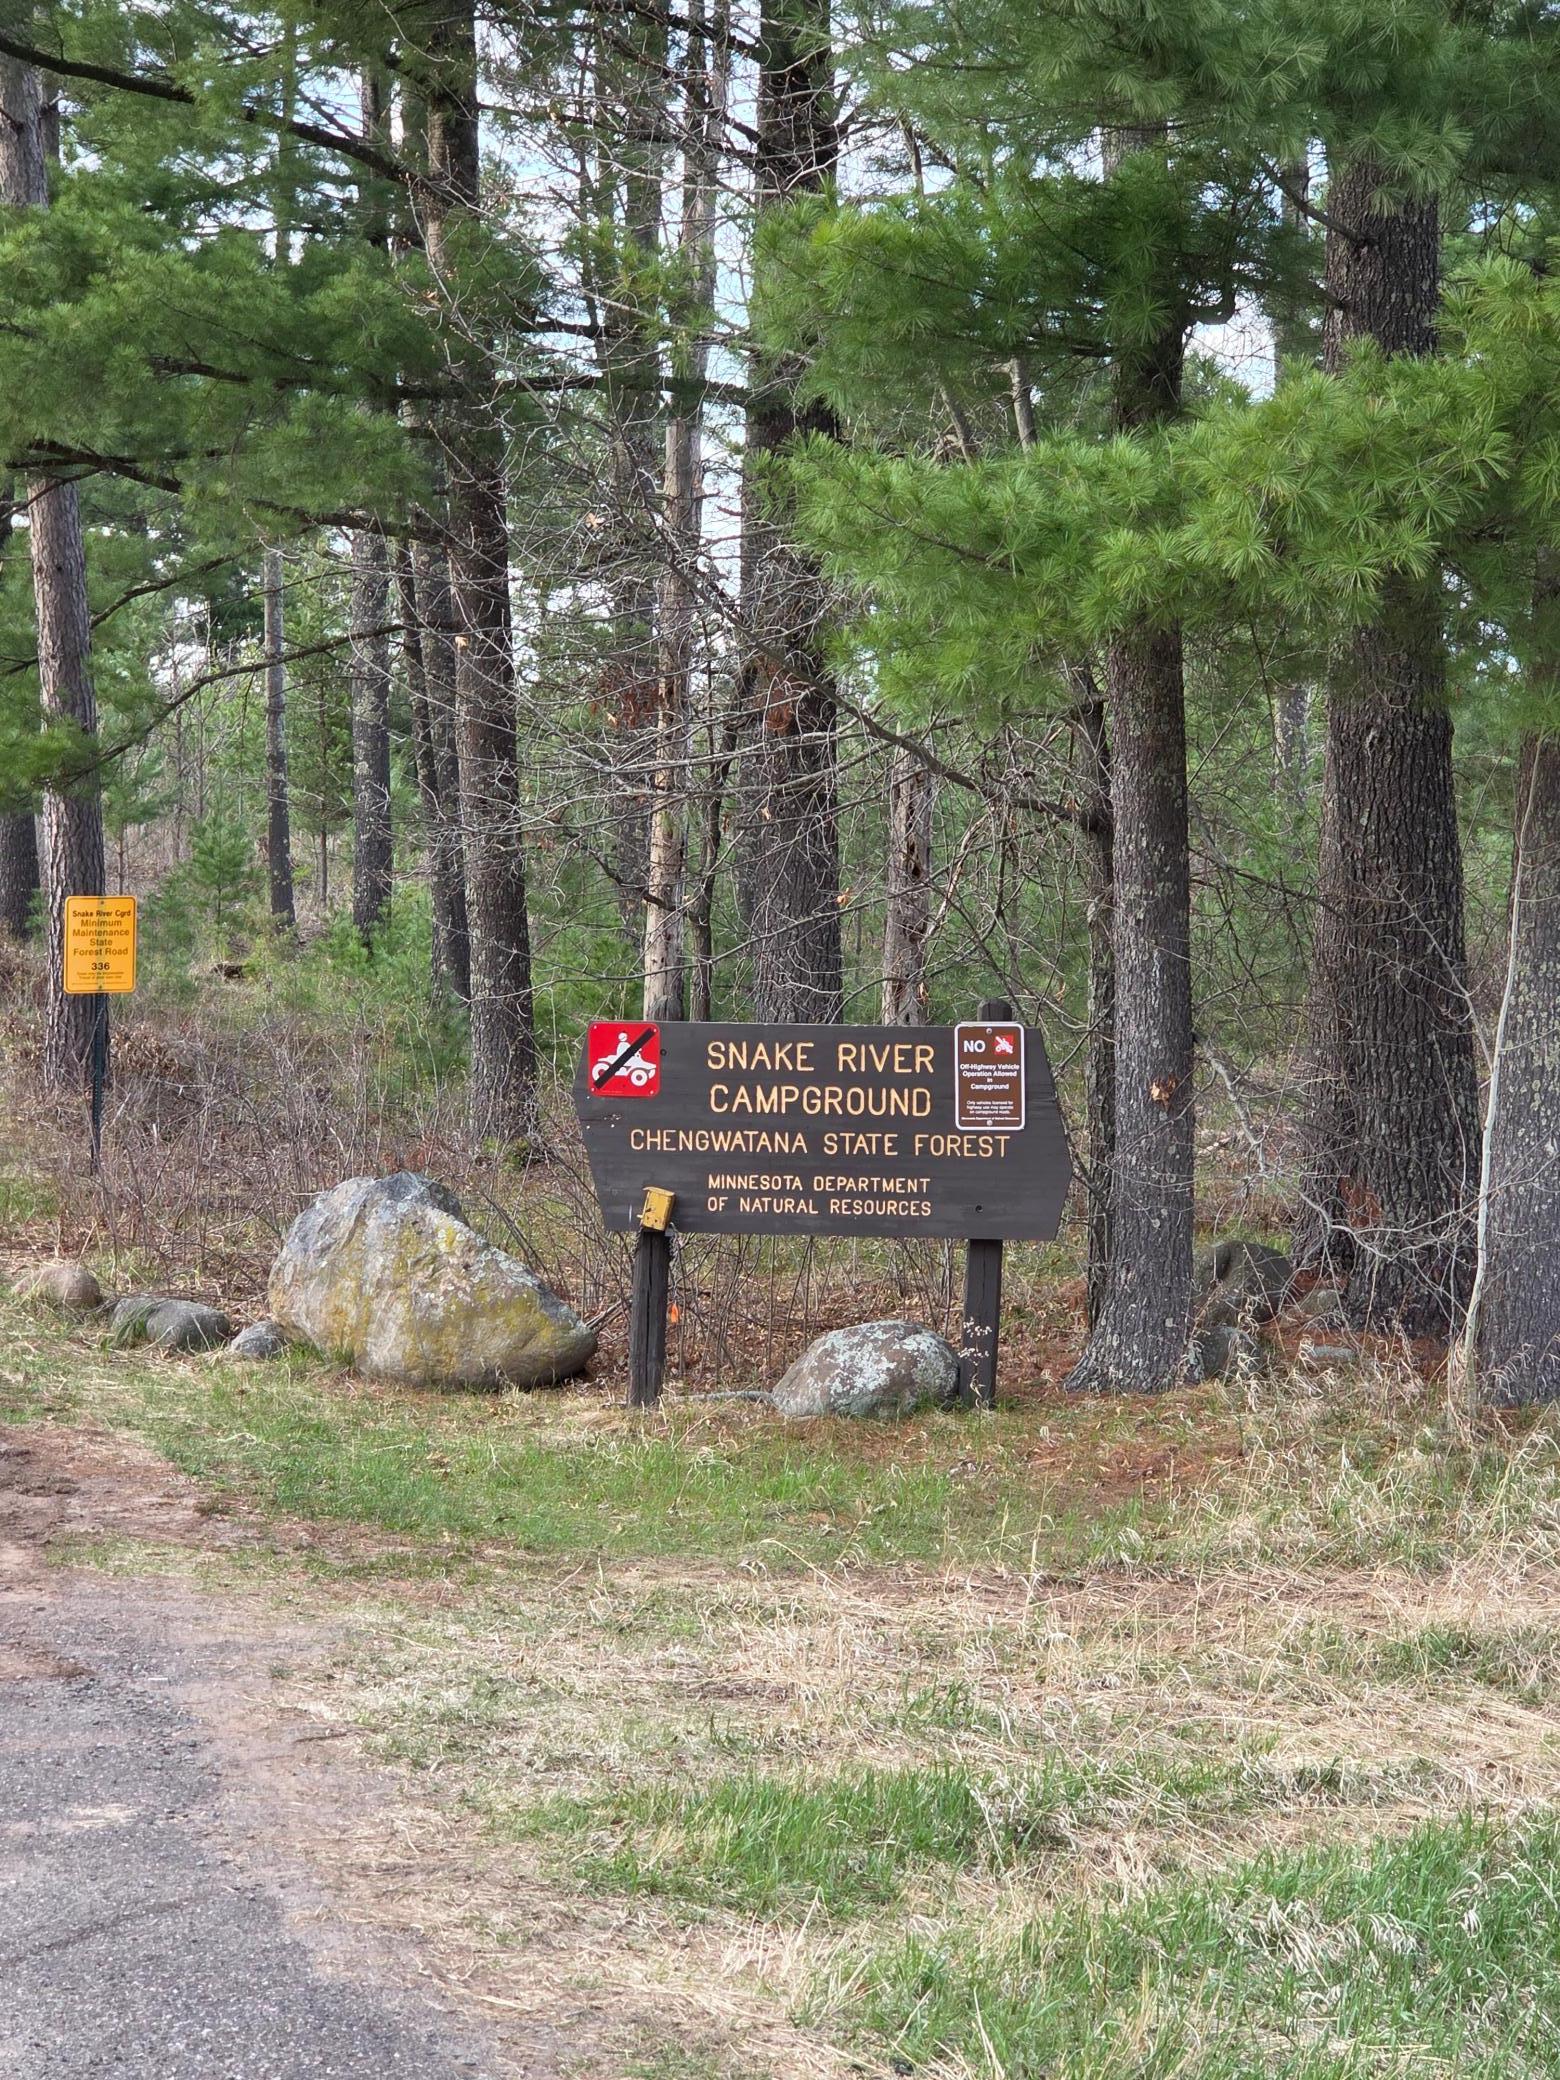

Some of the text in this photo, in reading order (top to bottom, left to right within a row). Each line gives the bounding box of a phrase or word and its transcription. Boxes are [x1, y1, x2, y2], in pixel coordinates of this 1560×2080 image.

[72, 910, 93, 918] Snake
[115, 909, 131, 918] Cgrd
[80, 919, 122, 927] Minimum
[72, 928, 130, 937] Maintenance
[89, 938, 113, 946] State
[73, 947, 128, 956] Forest Road
[91, 962, 110, 971] 336
[963, 1040, 985, 1053] NO
[708, 1042, 935, 1074] SNAKE RIVER
[960, 1063, 996, 1071] Off-Highway
[970, 1083, 1009, 1091] Campground
[709, 1085, 932, 1117] CAMPGROUND
[630, 1129, 1010, 1159] CHENGWATANA STATE FOREST
[708, 1174, 931, 1194] MINNESOTA DEPARTMENT
[707, 1196, 932, 1216] OF NATURAL RESOURCES
